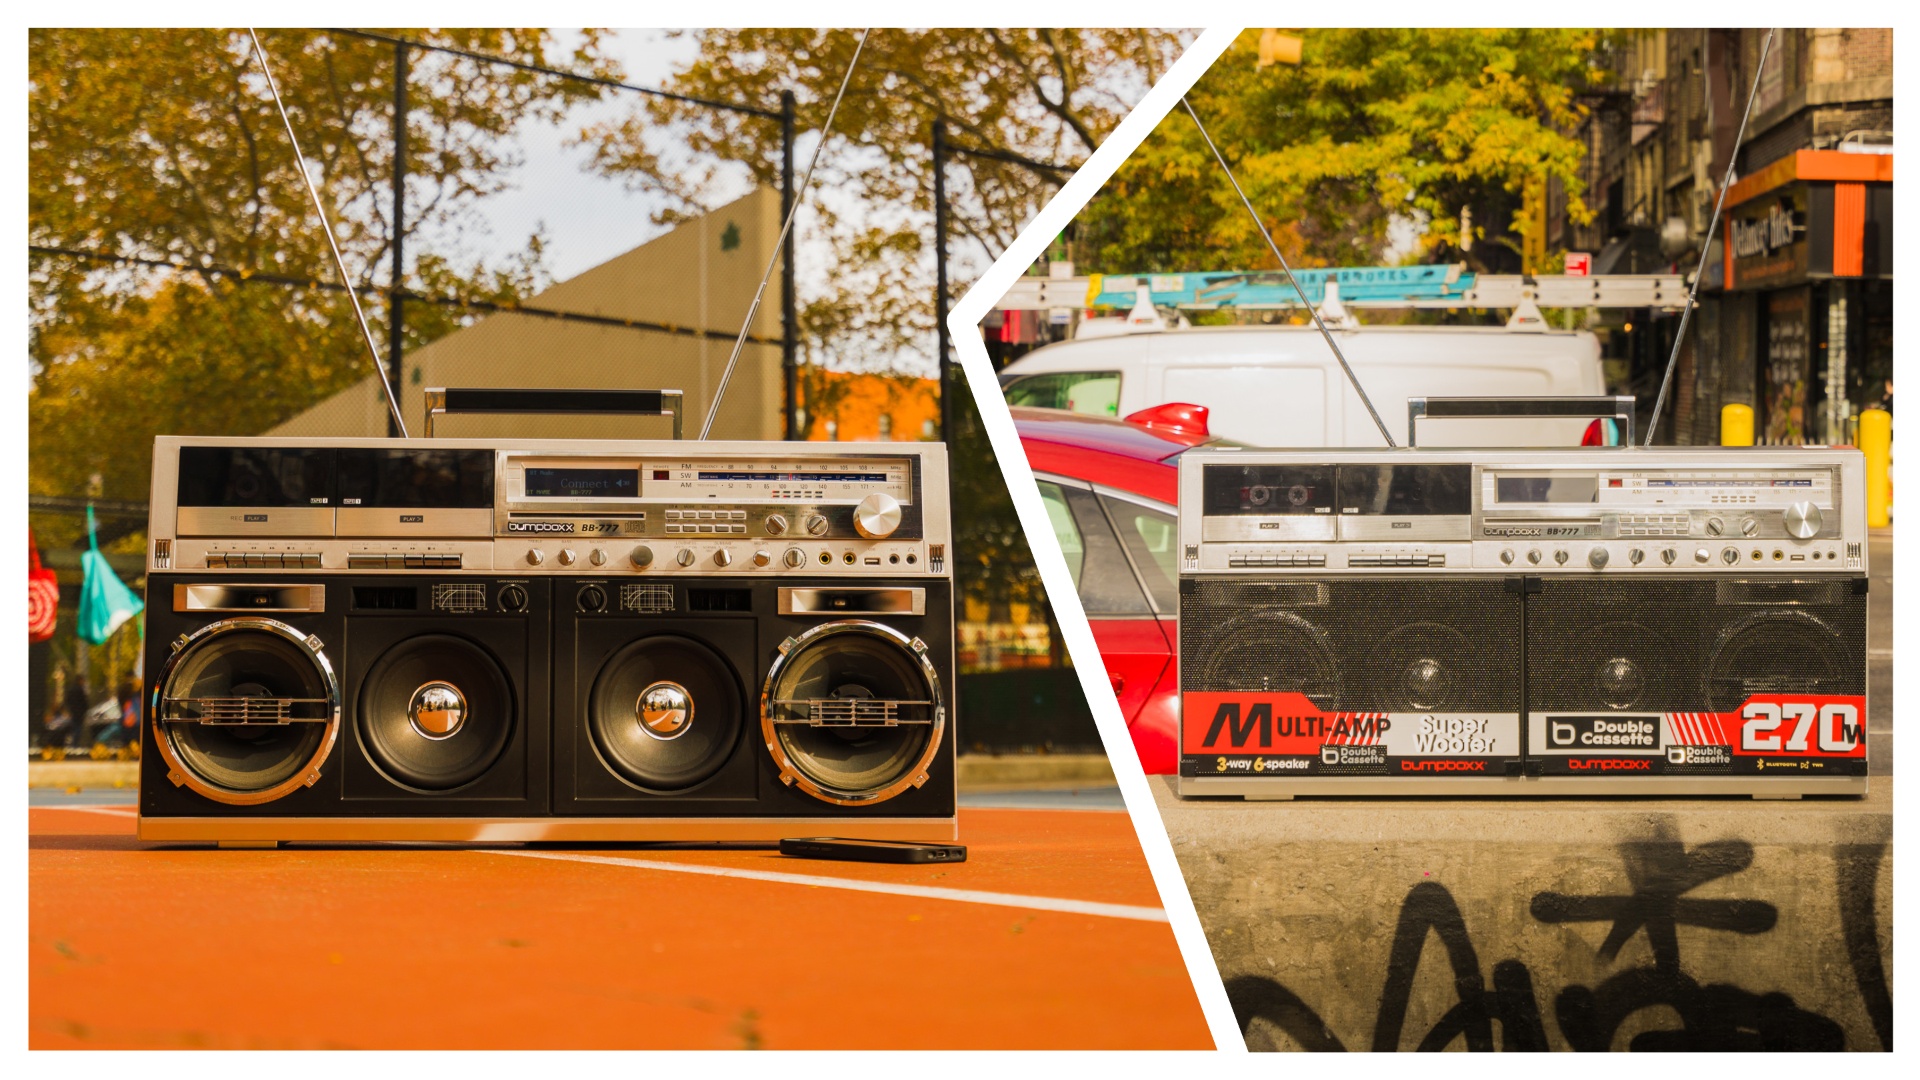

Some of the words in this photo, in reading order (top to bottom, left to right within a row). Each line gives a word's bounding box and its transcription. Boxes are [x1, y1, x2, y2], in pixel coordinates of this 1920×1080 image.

[561, 479, 609, 488] Connect
[508, 523, 574, 533] bumpboxx
[1484, 527, 1541, 537] bumpboxx
[1202, 703, 1391, 748] MULTI-AMP
[1420, 715, 1488, 738] Super
[1594, 720, 1654, 733] Double
[1413, 734, 1495, 753] Woofer
[1581, 733, 1654, 745] Cassette
[1341, 748, 1377, 756] Double
[1686, 747, 1722, 756] Double
[1217, 757, 1252, 772] 3-way
[1253, 757, 1310, 772] 6-speaker
[1340, 756, 1385, 764] Cassette
[1569, 759, 1651, 771] bumpboxx
[1686, 755, 1731, 764] Cassette
[1401, 760, 1485, 772] bumpboxx
